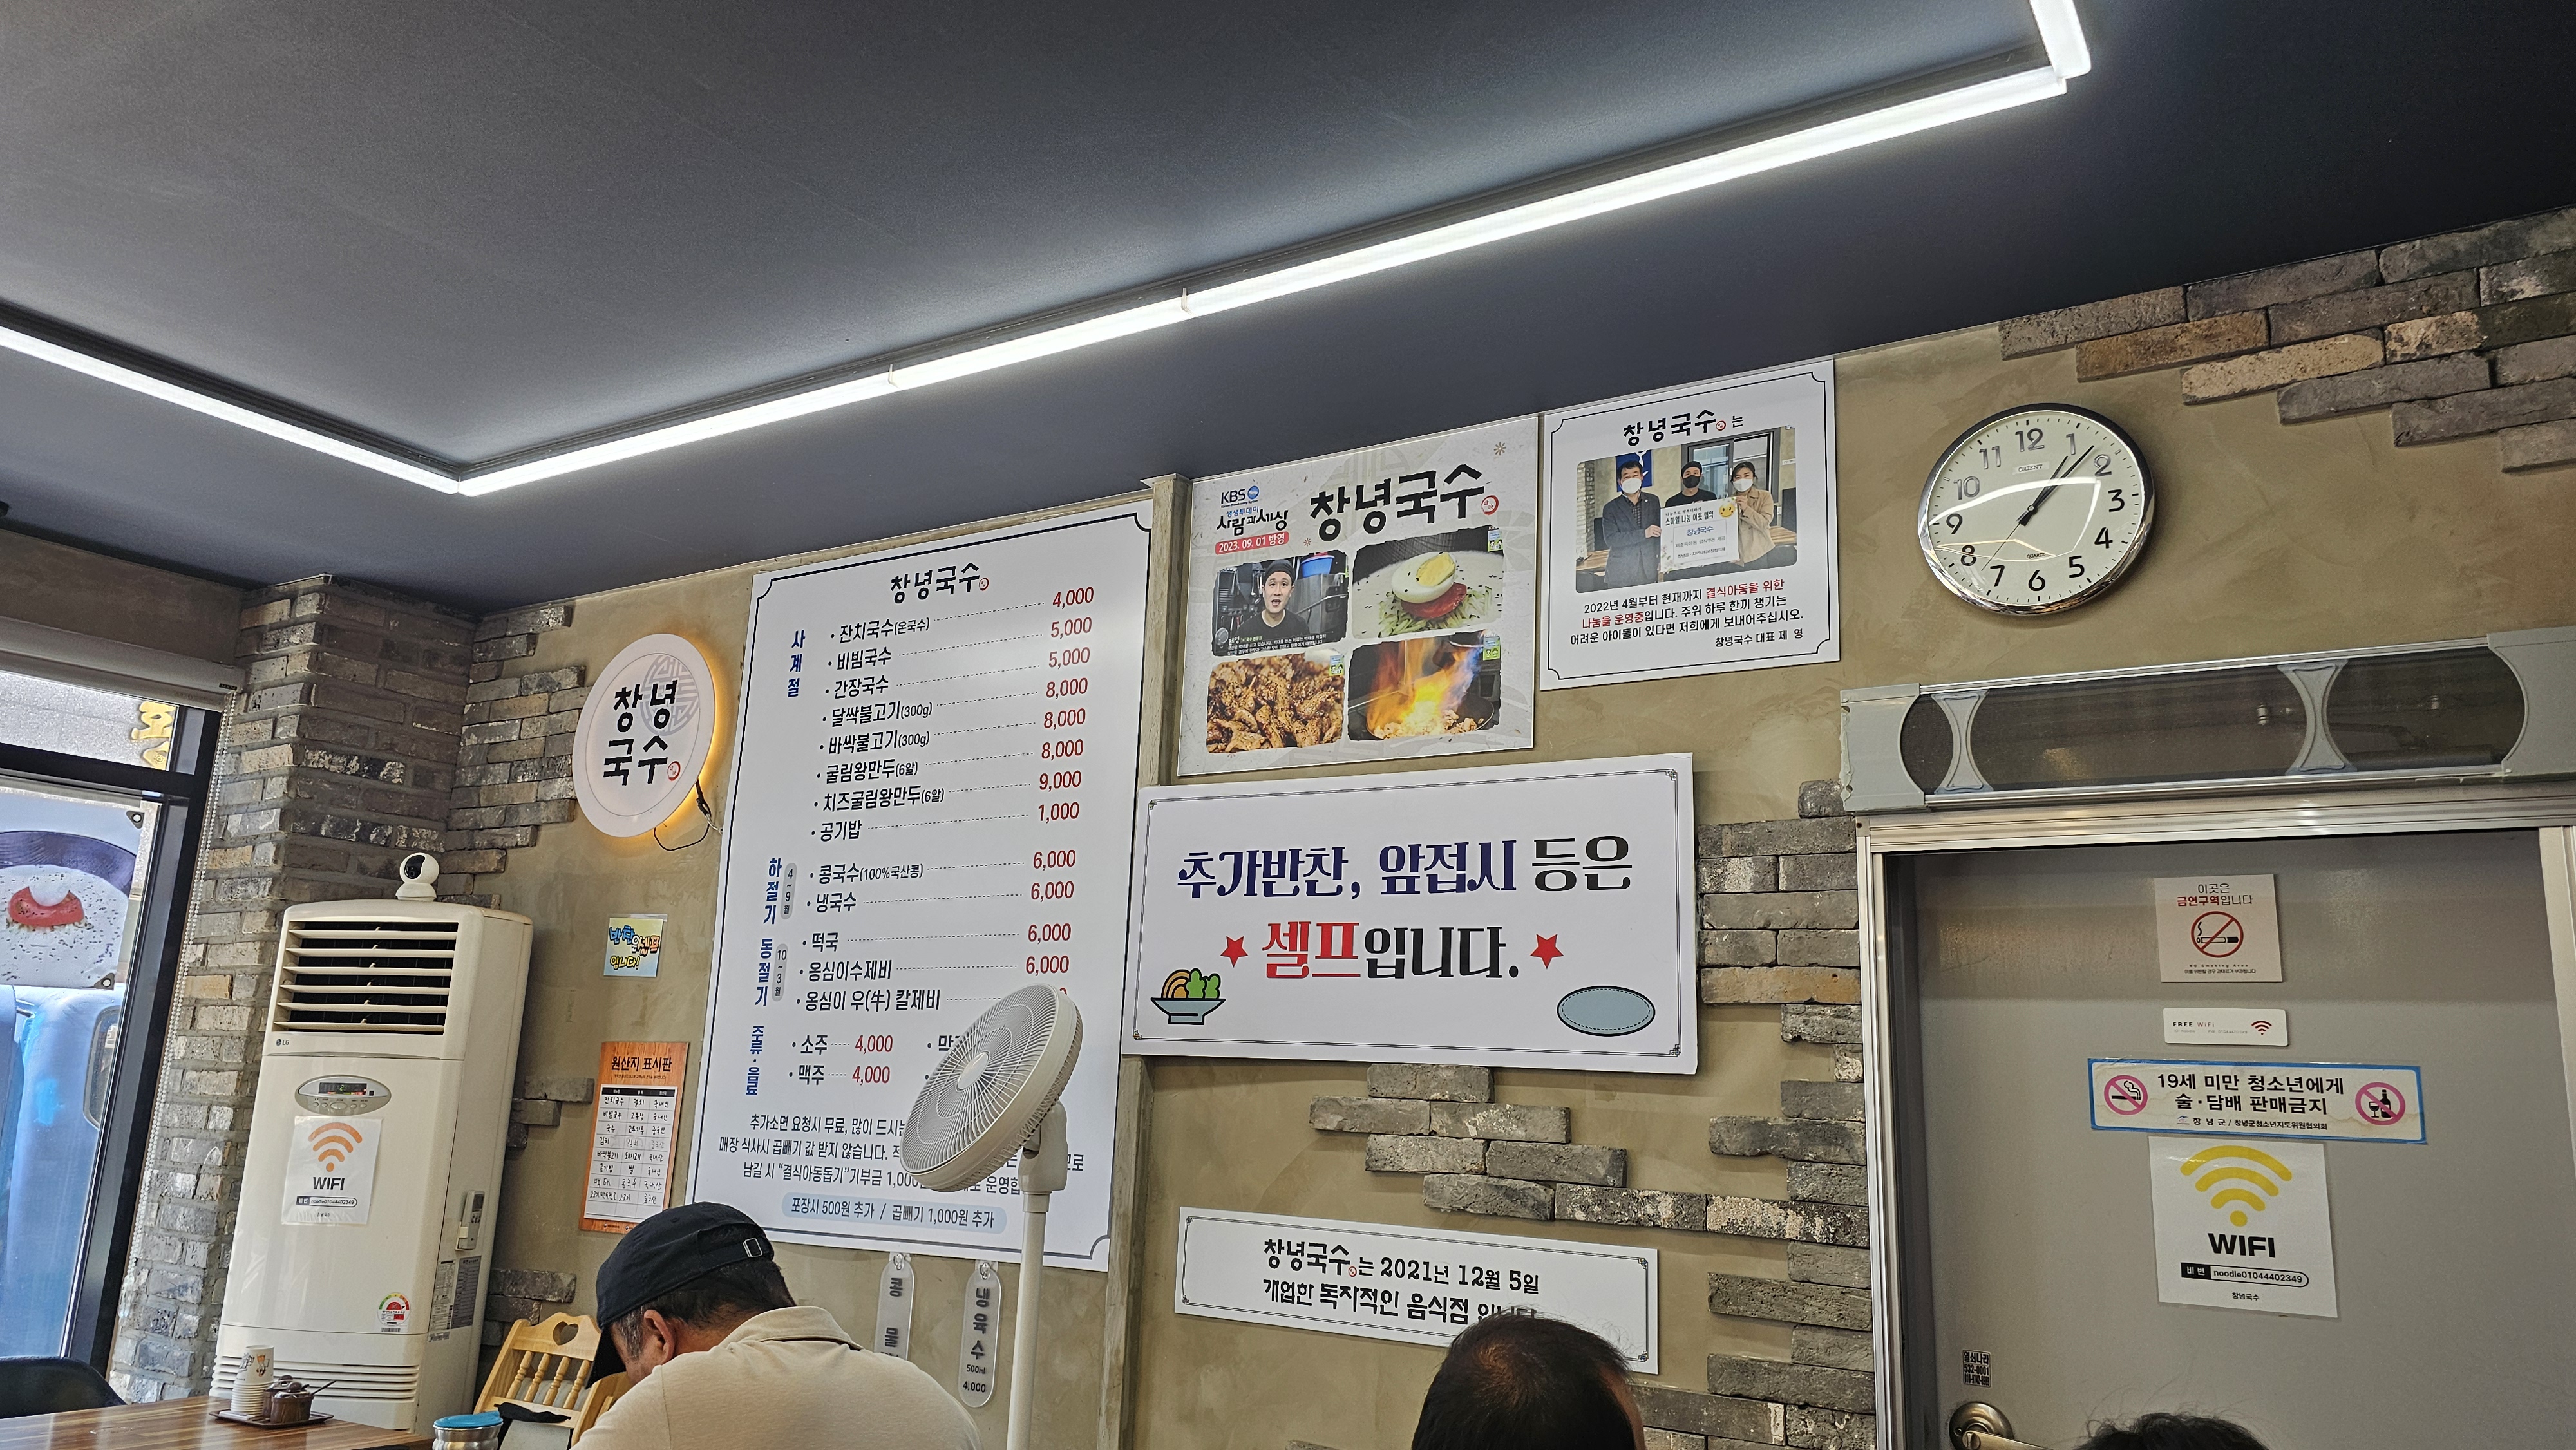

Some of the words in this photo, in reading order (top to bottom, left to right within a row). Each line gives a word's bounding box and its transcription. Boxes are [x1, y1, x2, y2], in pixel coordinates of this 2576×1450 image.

[1624, 410, 1716, 446] 창녕국수
[1732, 415, 1743, 428] 는
[2015, 428, 2045, 452] 12
[2066, 433, 2076, 455] 1
[1979, 446, 2002, 469] 11
[2018, 464, 2043, 472] ORIENT
[2093, 454, 2112, 477] 2
[1221, 489, 1245, 504] KBS
[1953, 476, 1980, 500] 10
[1227, 506, 1259, 518] 생생투데이
[1311, 464, 1484, 541] 창녕국수
[2108, 489, 2125, 512] 3
[1946, 513, 1963, 534] 9
[1219, 541, 1240, 552] 2023.
[1242, 539, 1253, 548] 09.
[1256, 536, 1265, 546] 01
[1269, 532, 1285, 546] 방영
[2094, 527, 2113, 549] 4
[1960, 544, 1977, 566] 8
[2069, 555, 2085, 578] 5
[891, 562, 980, 603] 창녕국수
[1990, 565, 2005, 587] 7
[2028, 569, 2046, 591] 6
[1584, 599, 1619, 614] 2022년
[1622, 595, 1658, 610] 4월부터
[1662, 588, 1703, 605] 현재까지
[1706, 582, 1759, 600] 결식아동을
[1763, 579, 1785, 592] 위한
[839, 616, 930, 644] 잔치국수(온국수)
[1052, 587, 1094, 608] 4,000
[1582, 614, 1611, 629] 나눔을
[1614, 608, 1678, 626] 운영중입니다.
[1681, 605, 1702, 618] 주위
[1705, 601, 1726, 615] 하루
[1730, 598, 1750, 612] 한끼
[1754, 595, 1787, 609] 챙기는
[1570, 631, 1600, 646] 어려운
[1602, 626, 1642, 643] 아이들이
[1645, 623, 1676, 637] 있다면
[1679, 618, 1721, 634] 저희에게
[1724, 608, 1804, 628] 보내어주십시오.
[1715, 634, 1753, 648] 창녕국수
[1756, 630, 1775, 644] 대표
[1777, 630, 1788, 641] 제
[1794, 627, 1804, 639] 영
[837, 646, 891, 670] 비빔국수
[1050, 616, 1092, 638] 5,000
[786, 629, 805, 698] 사계절
[834, 675, 889, 699] 간장국수
[1048, 647, 1090, 668] 5,000
[613, 679, 678, 733] 창녕
[831, 701, 933, 728] 달싹불고기(300g)
[1046, 677, 1088, 699] 8,000
[828, 730, 930, 755] 바싹불고기(300g)
[1043, 708, 1086, 730] 8,000
[603, 735, 668, 786] 국수
[826, 758, 918, 784] 굴림왕만두(6알)
[1041, 739, 1084, 760] 8,000
[823, 785, 945, 813] 치즈굴림왕만두(6알)
[1039, 770, 1082, 791] 9,000
[820, 820, 862, 842] 공기밥
[1037, 802, 1080, 823] 1,000
[819, 863, 923, 884] 콩국수(100%국산콩)
[1033, 850, 1076, 871] 6,000
[1177, 845, 1361, 901] 추가반찬,
[1378, 838, 1517, 896] 앞접시
[1531, 834, 1633, 893] 등은
[763, 858, 782, 925] 하절기
[816, 892, 857, 913] 냉국수
[1030, 881, 1074, 902] 6,000
[2197, 883, 2230, 894] 이곳은
[2177, 895, 2253, 907] 금연구역입니다
[811, 932, 838, 952] 떡국
[1028, 923, 1072, 944] 6,000
[1262, 919, 1519, 981] 셀프입니다.
[610, 956, 641, 970] 입니다!
[755, 938, 773, 1006] 동절기
[808, 959, 892, 982] 옹심이수제비
[1025, 956, 1069, 976] 6,000
[805, 990, 846, 1012] 옹심이
[895, 989, 941, 1011] 칼제비
[800, 1035, 828, 1055] 소주
[855, 1035, 893, 1055] 4,000
[611, 1056, 639, 1072] 원산지
[642, 1057, 672, 1072] 표시판
[798, 1065, 825, 1086] 맥주
[851, 1066, 890, 1086] 4,000
[2157, 1073, 2196, 1089] 19세
[2204, 1074, 2240, 1091] 미만
[2248, 1075, 2344, 1095] 청소년에게
[2249, 1096, 2327, 1115] 판매금지
[750, 1114, 789, 1131] 추가소면
[791, 1116, 822, 1133] 요청시
[824, 1118, 848, 1134] 무료,
[851, 1118, 873, 1135] 많이
[2235, 1119, 2327, 1130] 창녕군청소년지도위원협의회
[719, 1136, 739, 1153] 매장
[741, 1138, 770, 1154] 식사시
[773, 1139, 802, 1156] 곱빼기
[805, 1140, 815, 1157] 값
[819, 1142, 838, 1158] 받지
[842, 1142, 888, 1161] 않습니다.
[744, 1162, 762, 1179] 남길
[765, 1163, 775, 1179] 시
[313, 1176, 345, 1191] WIFI
[791, 1197, 819, 1216] 포장시
[821, 1199, 850, 1218] 500원
[853, 1200, 875, 1219] 추가
[880, 1203, 887, 1220] /
[892, 1204, 923, 1223] 곱빼기
[928, 1207, 968, 1228] 1,000원
[972, 1210, 994, 1229] 추가
[2208, 1232, 2276, 1258] WIFI
[1264, 1239, 1350, 1276] 창녕국수
[1358, 1257, 1374, 1277] 는
[1381, 1257, 1449, 1285] 2021년
[1458, 1264, 1501, 1290] 12월
[1509, 1269, 1539, 1295] 5일
[2213, 1269, 2303, 1283] noodle01044402349
[1263, 1279, 1314, 1306] 개업한
[1406, 1292, 1469, 1325] 음식점
[2231, 1292, 2260, 1301] 창녕국수
[966, 1364, 986, 1375] 500ml
[1964, 1351, 1990, 1366] 열쇠나라
[1964, 1364, 1990, 1376] 532-0001
[963, 1380, 986, 1393] 4,000
